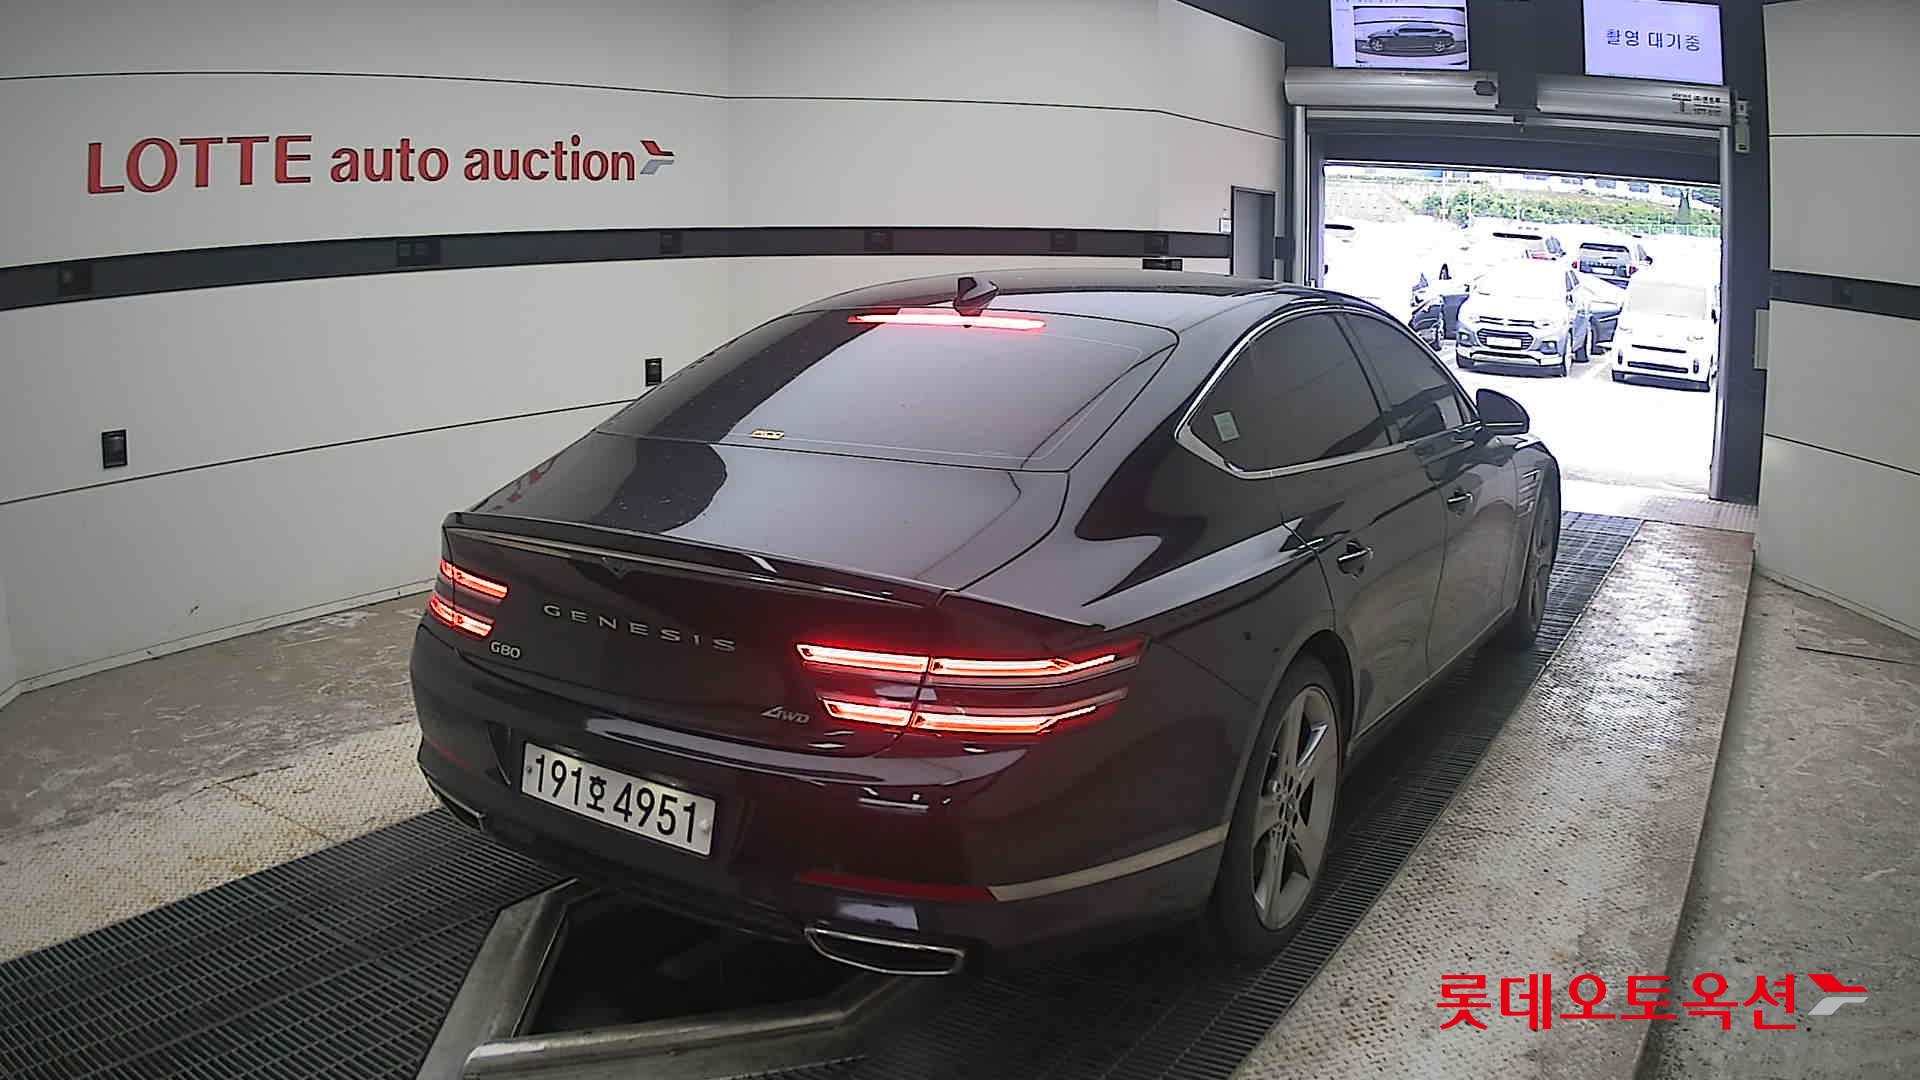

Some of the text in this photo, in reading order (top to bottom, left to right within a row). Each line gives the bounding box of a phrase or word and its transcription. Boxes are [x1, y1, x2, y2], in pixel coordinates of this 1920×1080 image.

[1647, 31, 1701, 52] 대기중
[87, 134, 636, 194] LOTTE auto auction
[543, 604, 736, 652] GENESIS
[490, 640, 521, 659] G80
